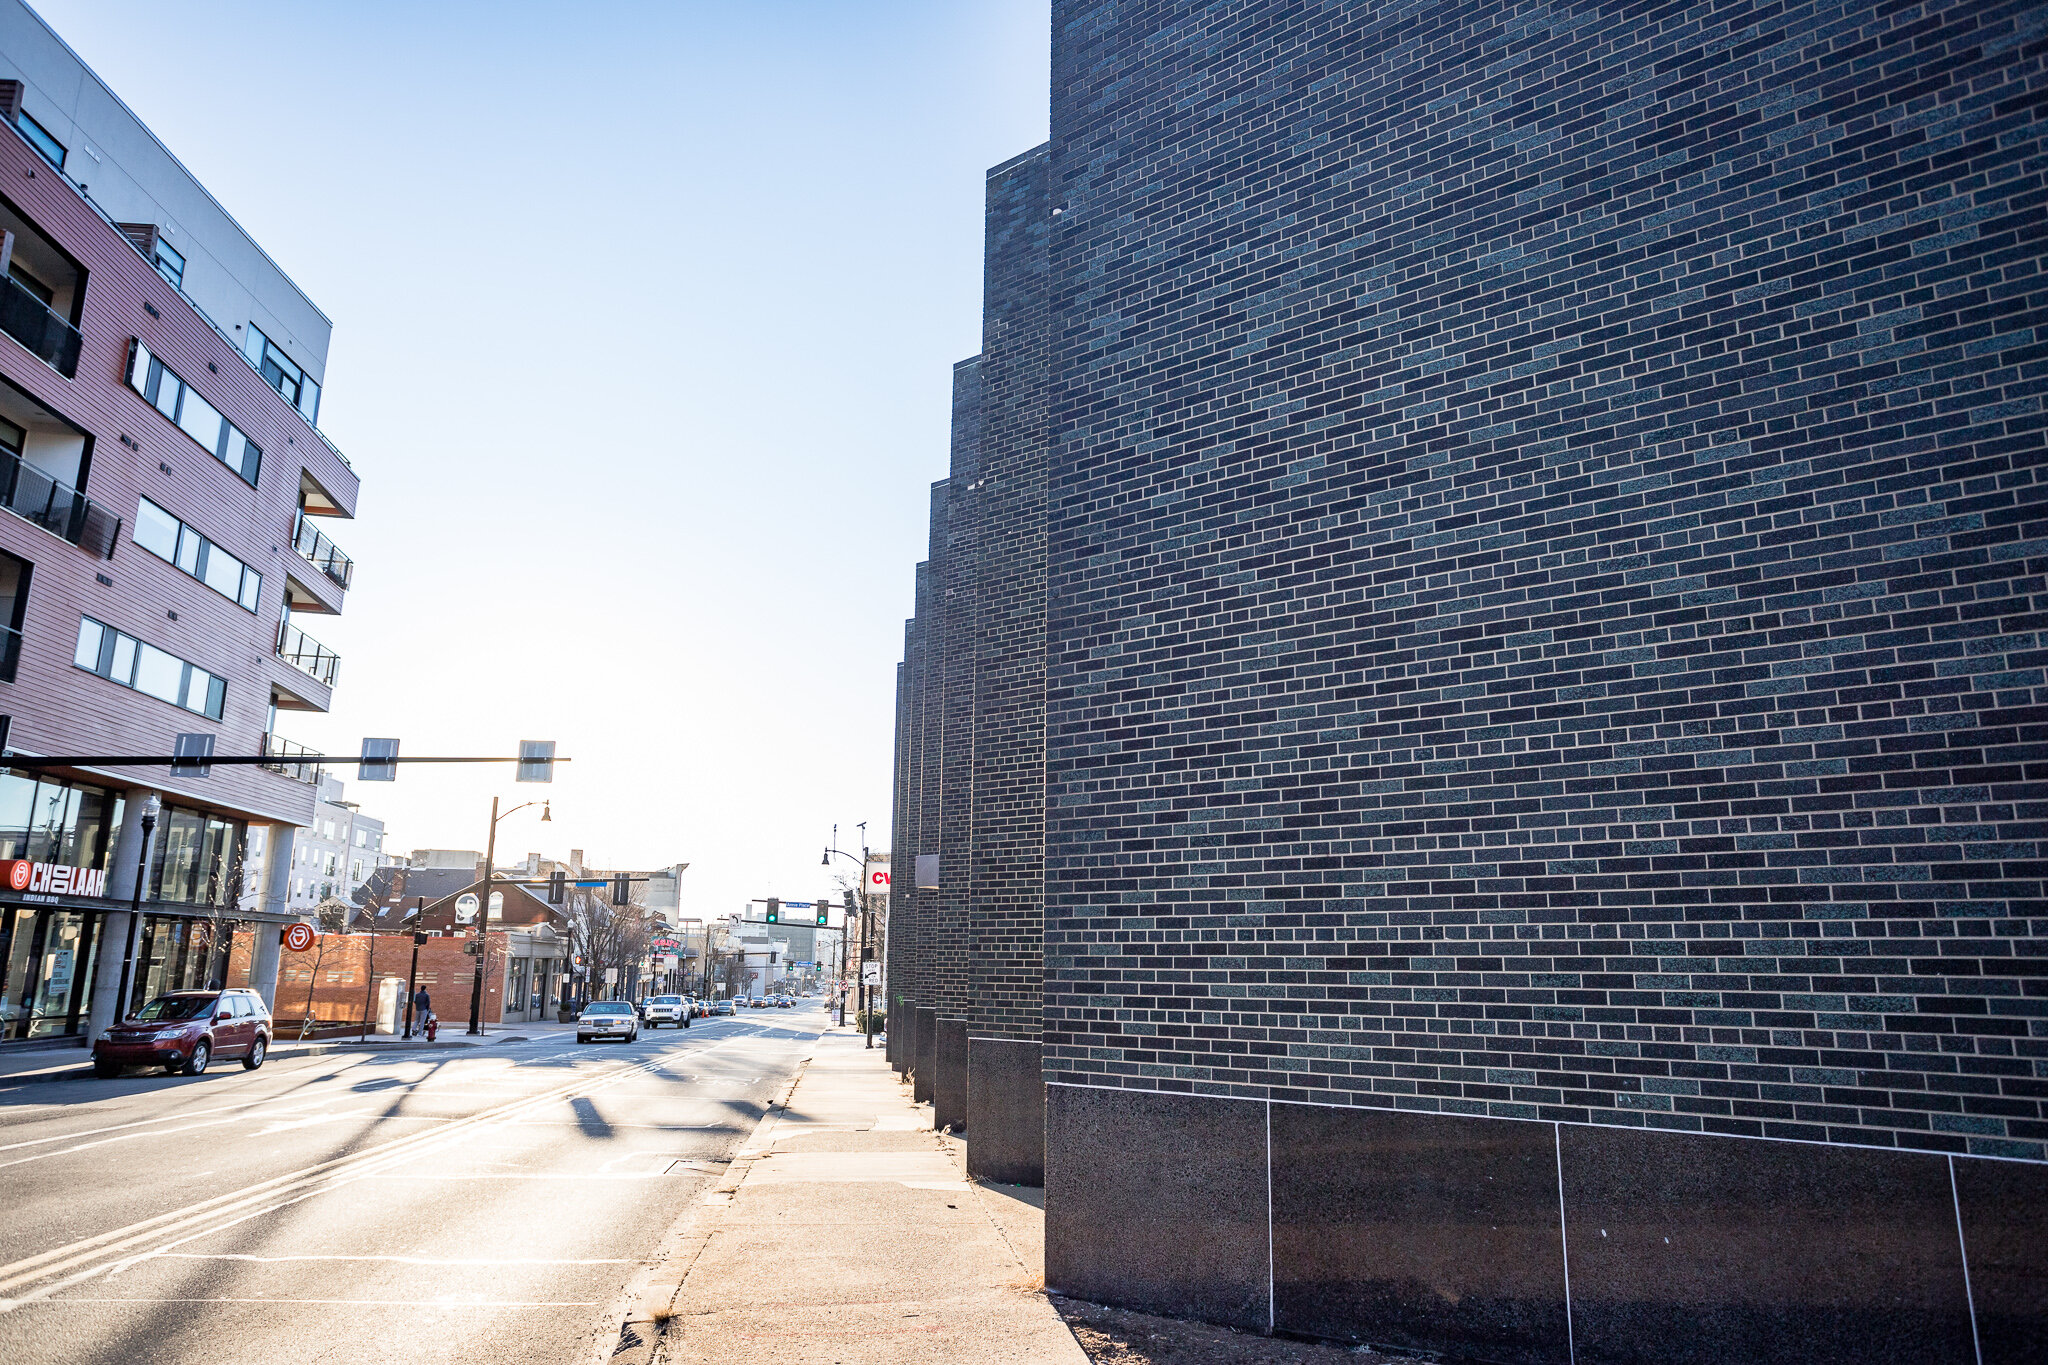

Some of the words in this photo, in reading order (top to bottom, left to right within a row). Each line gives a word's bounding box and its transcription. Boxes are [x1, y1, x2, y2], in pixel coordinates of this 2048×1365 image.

[29, 861, 106, 897] CHOOLAAH
[872, 872, 891, 884] CV
[22, 893, 45, 903] INDIAN
[46, 895, 60, 905] BBQ
